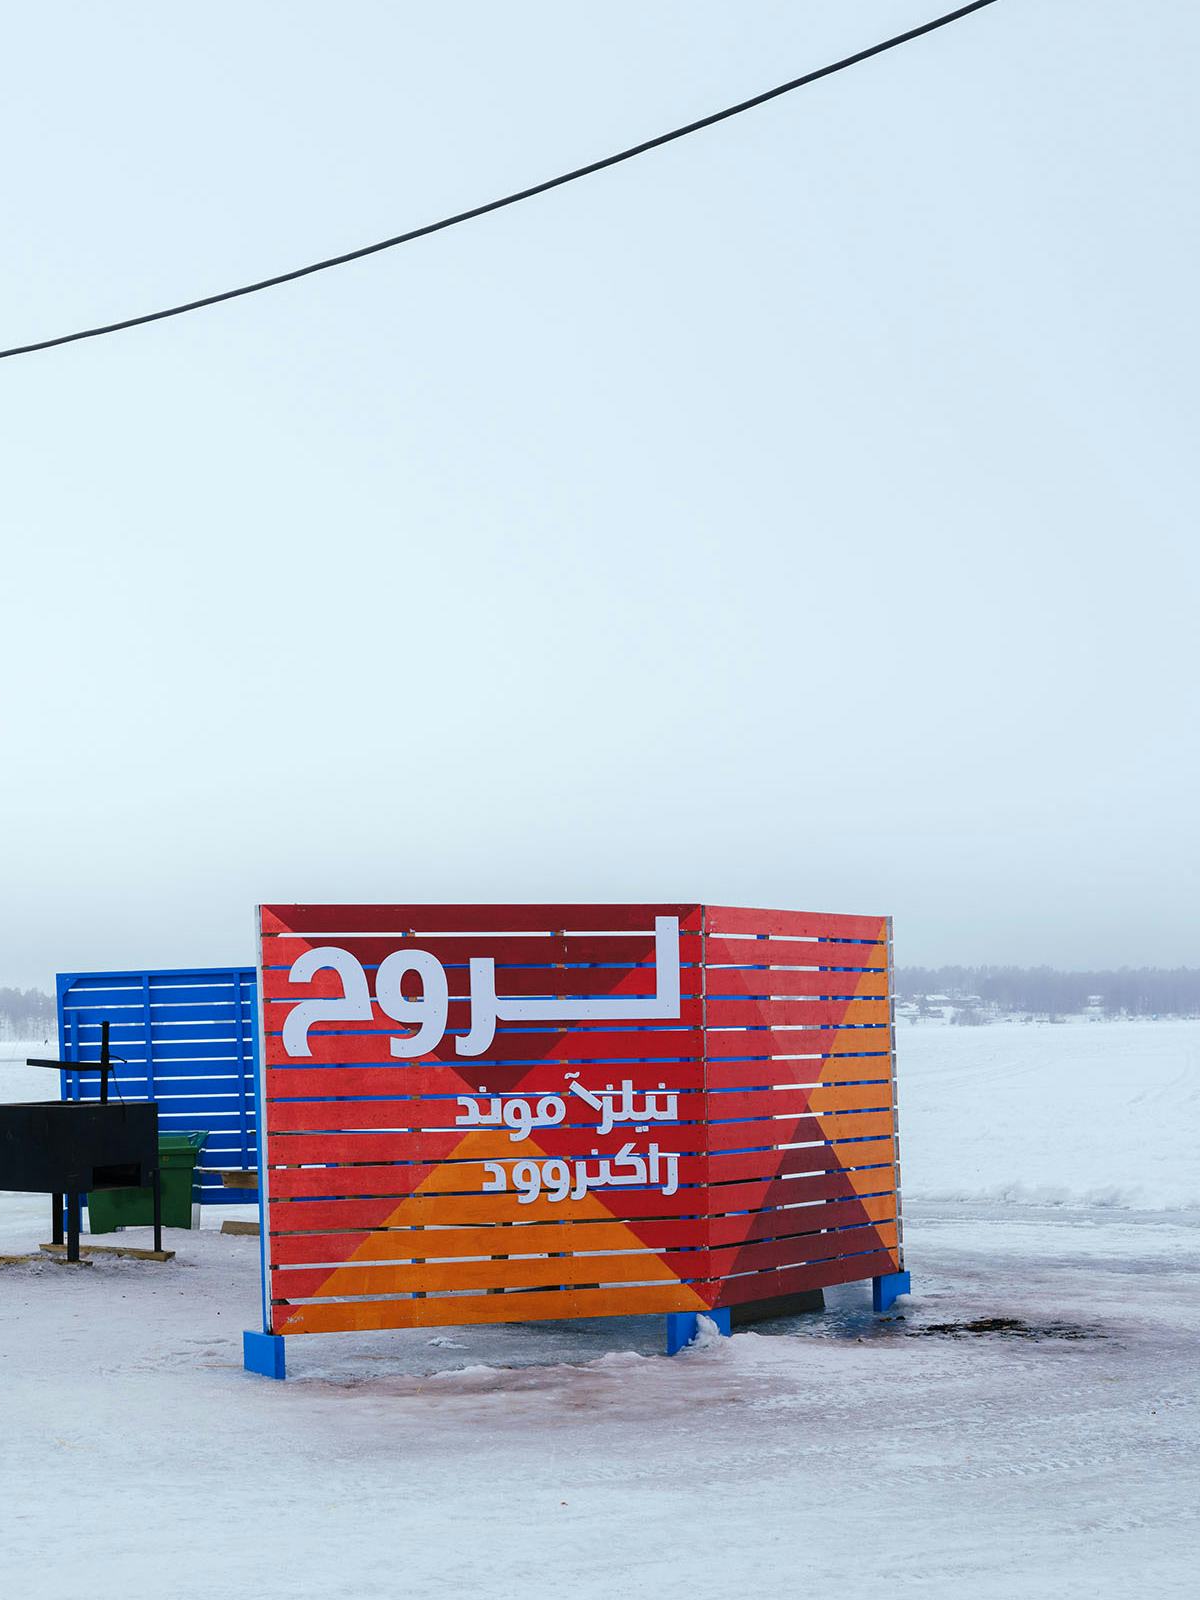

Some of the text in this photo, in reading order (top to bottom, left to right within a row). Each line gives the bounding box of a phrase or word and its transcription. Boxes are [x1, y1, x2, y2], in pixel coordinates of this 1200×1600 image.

[282, 916, 681, 1058] لروح
[597, 1079, 678, 1135] نيلز
[482, 1142, 679, 1204] راكنروود
